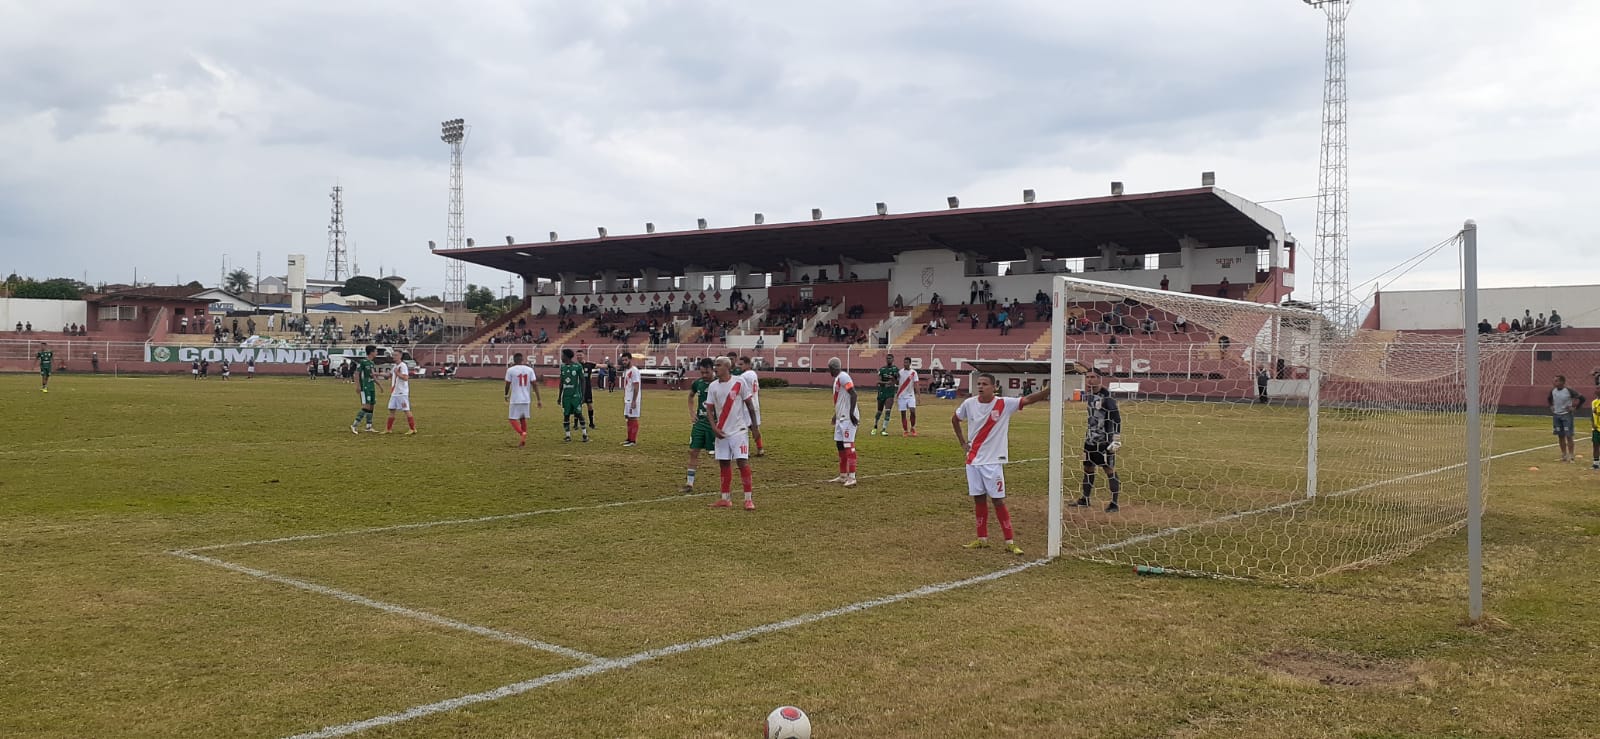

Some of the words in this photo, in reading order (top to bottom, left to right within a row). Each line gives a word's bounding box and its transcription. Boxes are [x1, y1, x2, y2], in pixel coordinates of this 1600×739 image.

[517, 373, 528, 387] 11
[739, 445, 748, 455] 10
[996, 480, 1003, 493] 2
